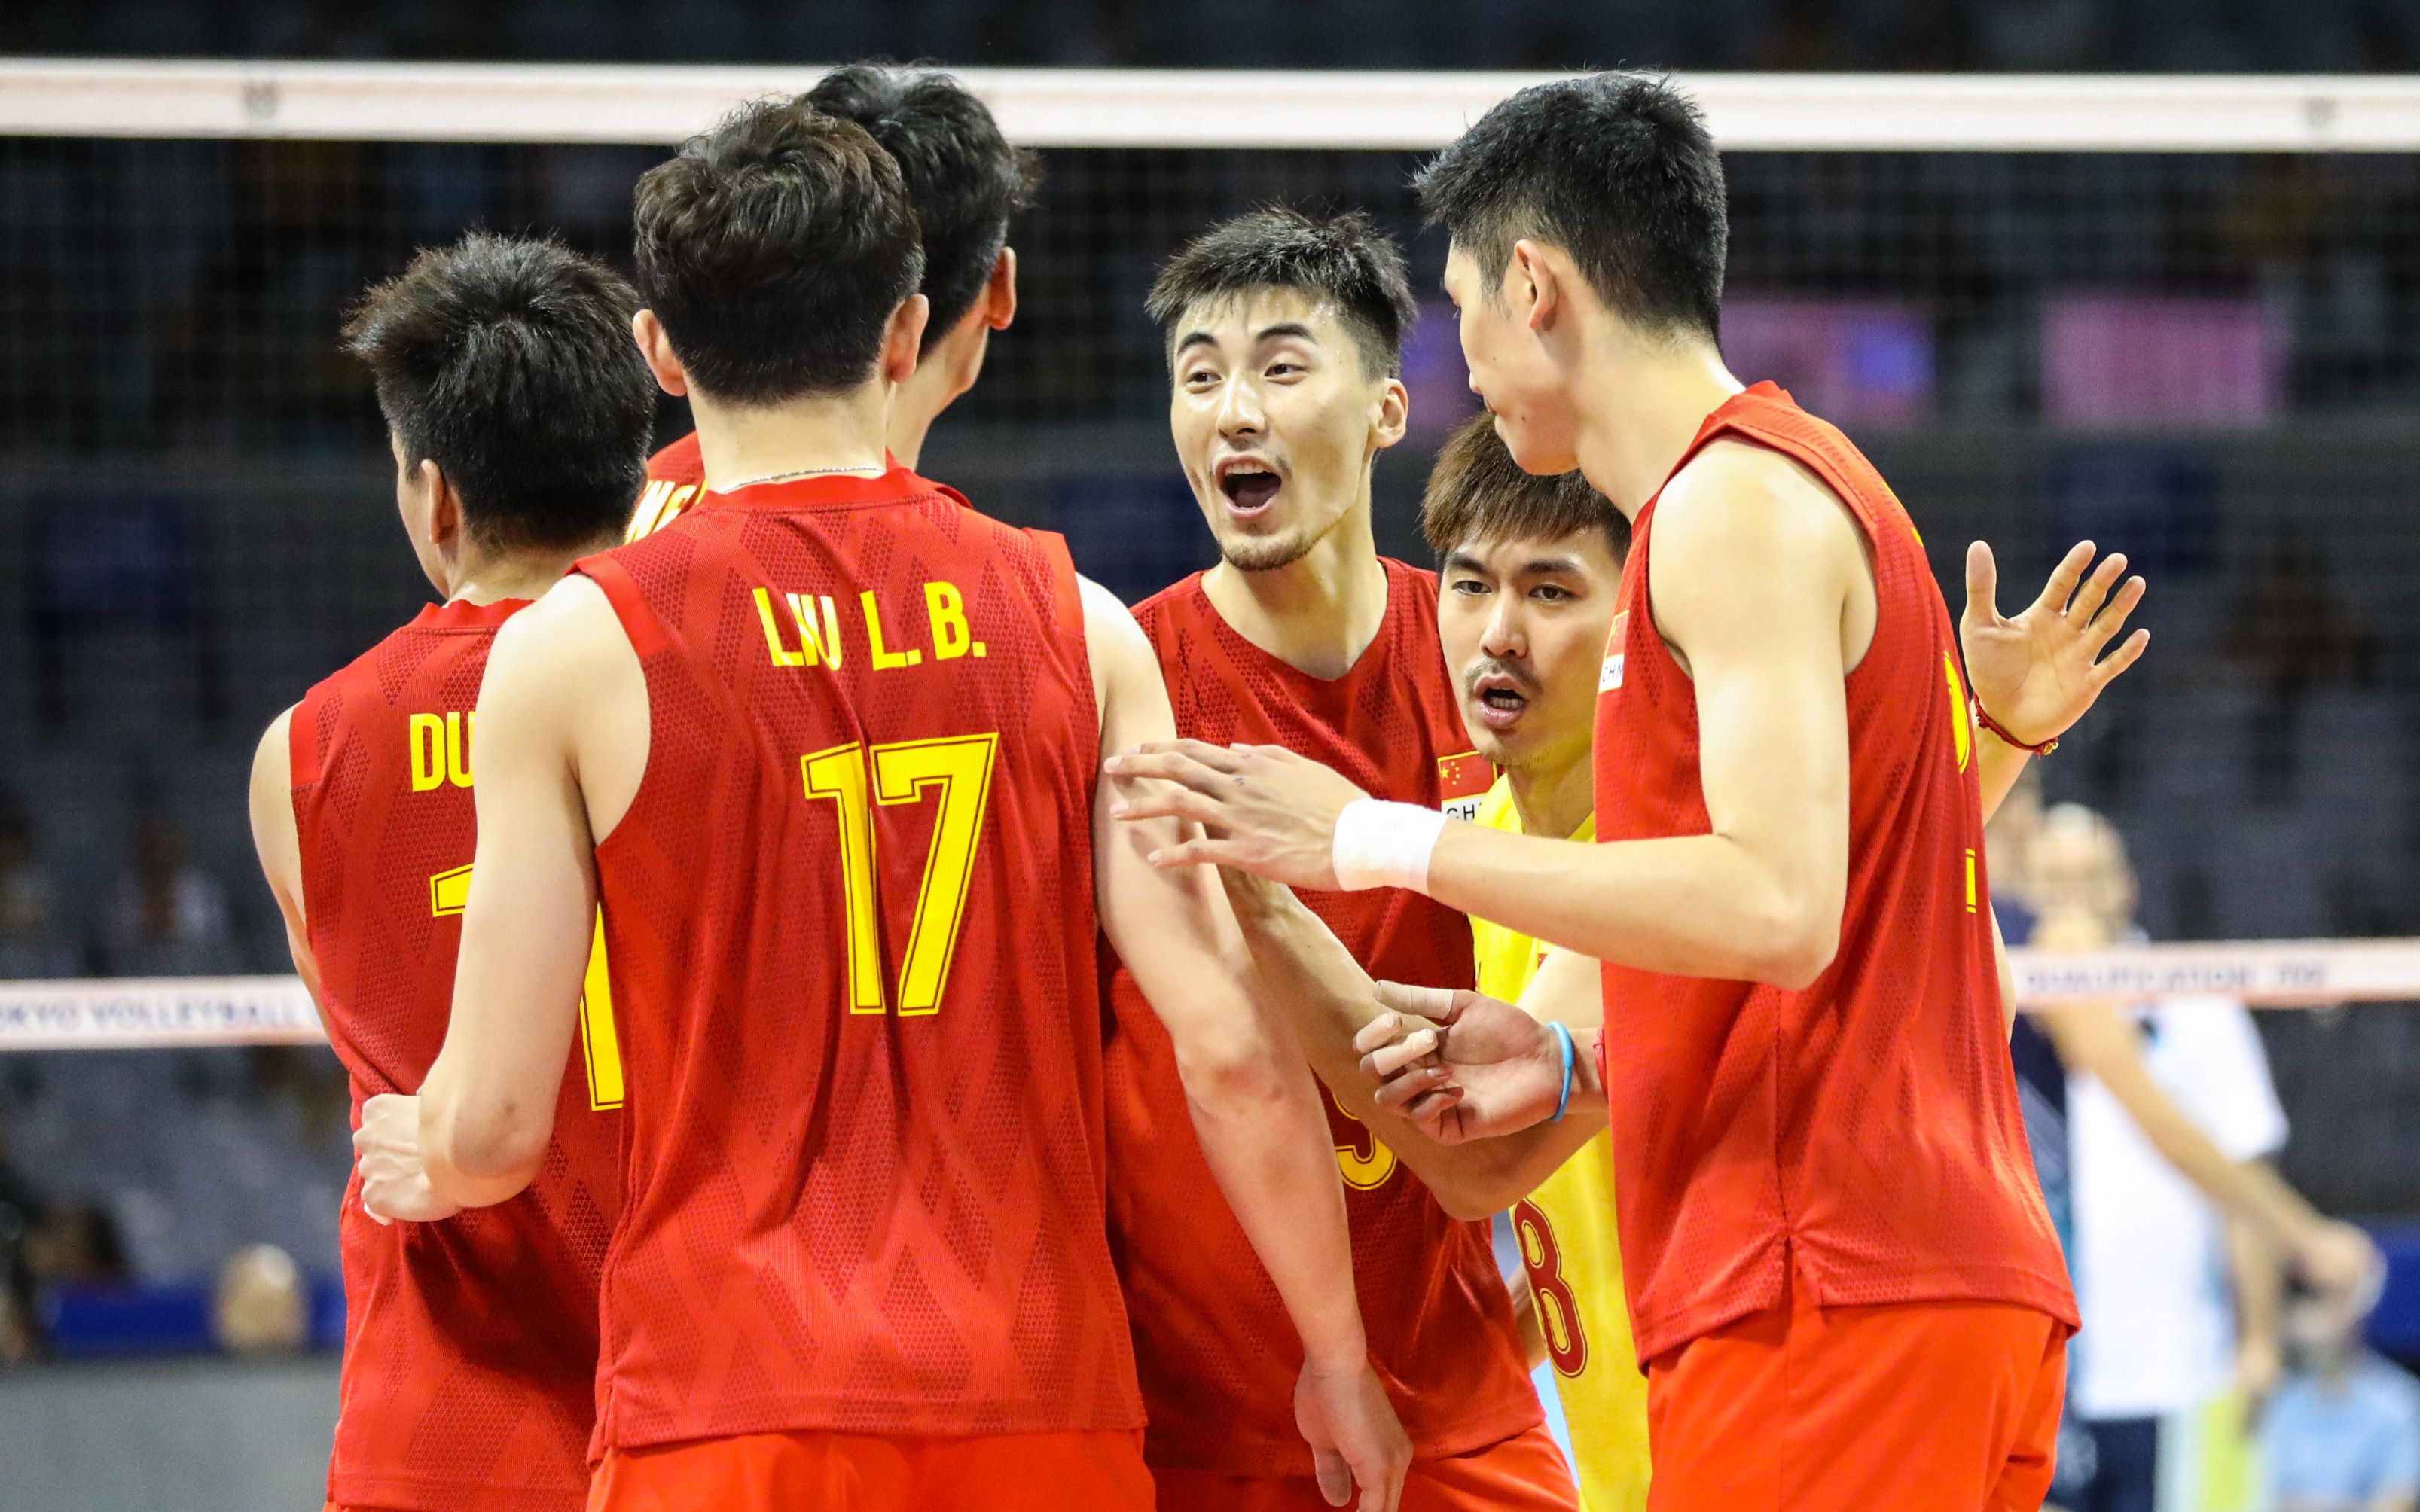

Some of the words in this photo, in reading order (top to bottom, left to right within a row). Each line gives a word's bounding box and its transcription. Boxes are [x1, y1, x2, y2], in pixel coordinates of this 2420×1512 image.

[752, 587, 842, 671] LIU
[801, 732, 998, 1017] 17
[87, 995, 300, 1029] VOLLEYBALL
